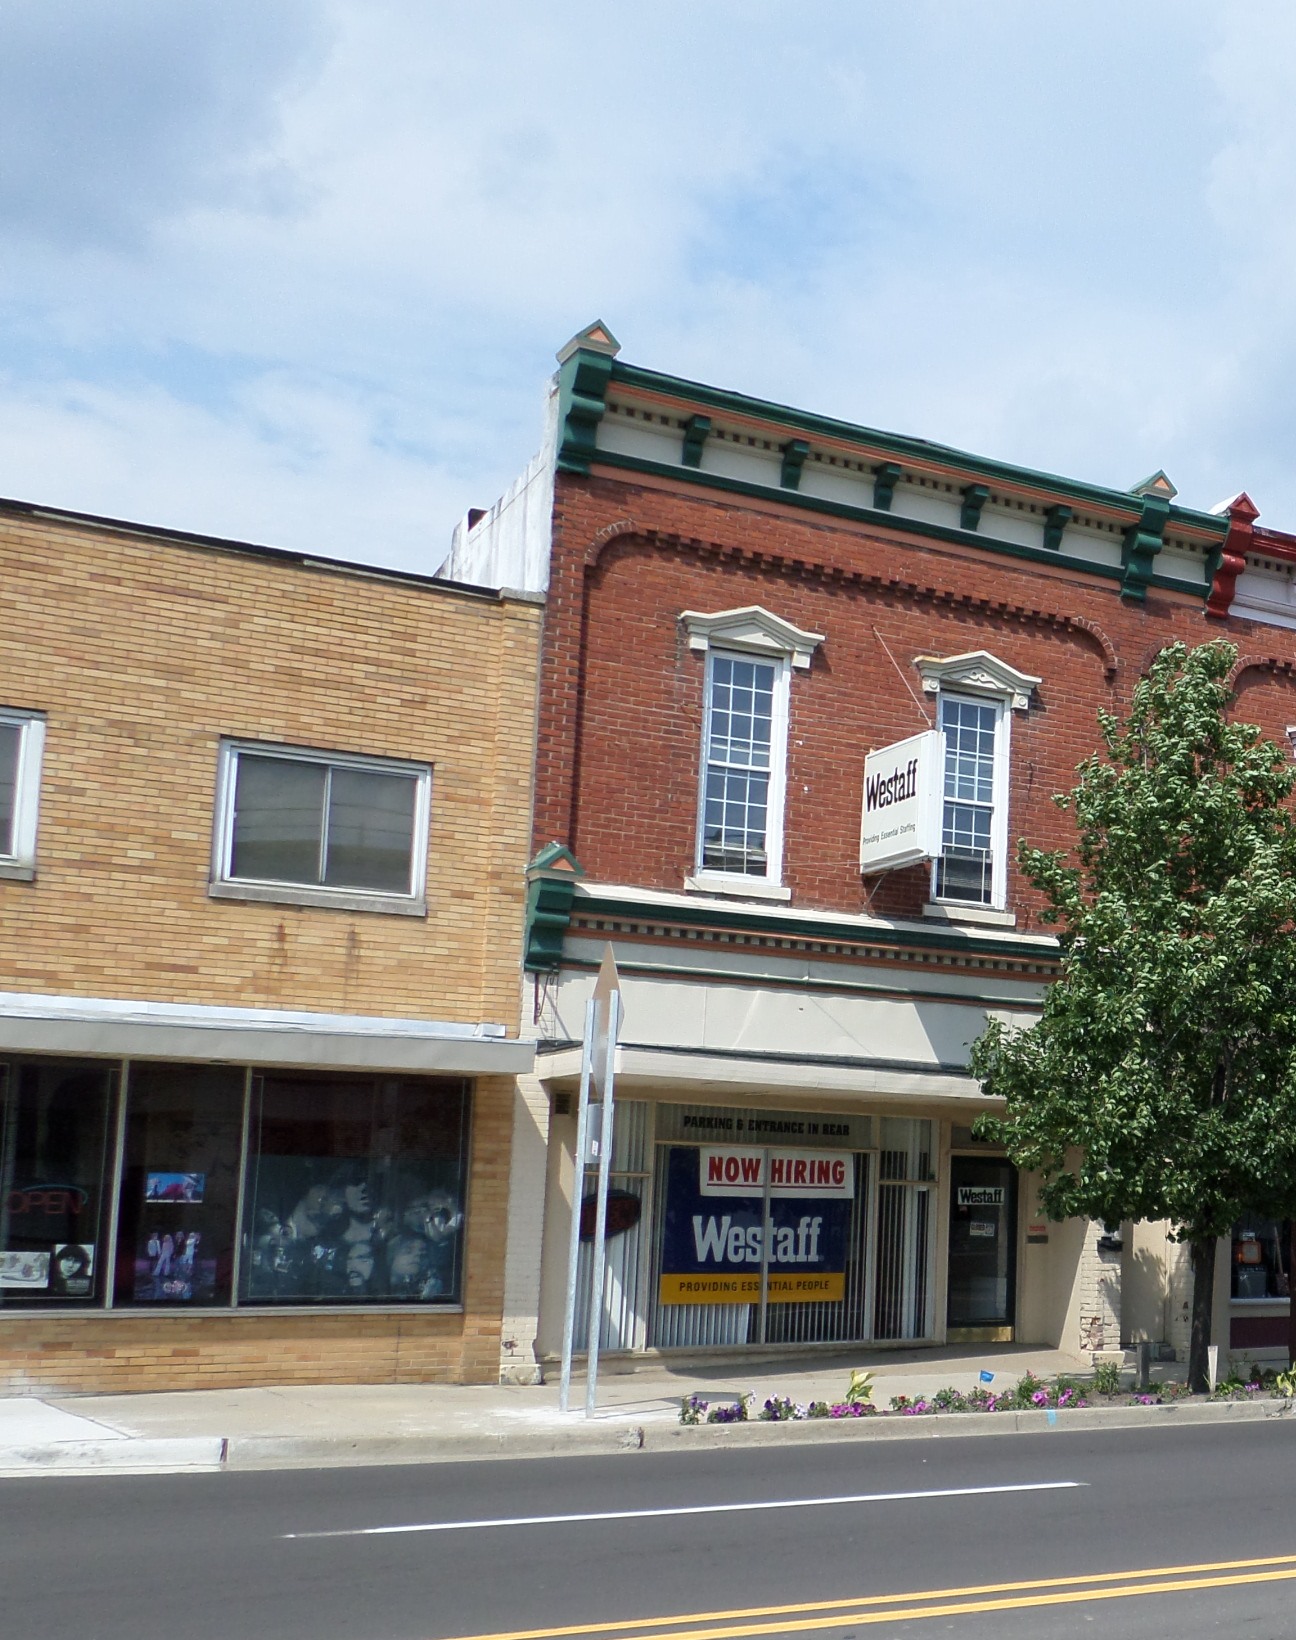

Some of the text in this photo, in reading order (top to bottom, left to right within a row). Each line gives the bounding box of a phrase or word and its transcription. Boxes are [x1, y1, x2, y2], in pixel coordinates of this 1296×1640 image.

[866, 758, 919, 813] Westaff
[862, 823, 916, 845] Providing Essential Staffing
[683, 1115, 850, 1136] PARKING & ENTRANCE IN REAR
[708, 1156, 845, 1185] NOW HIRING
[7, 1191, 83, 1214] OPEN
[959, 1188, 1004, 1204] Westaff
[692, 1215, 823, 1263] Westaff
[679, 1280, 829, 1292] PROVIDING ESSNTIAL PEOPLE
